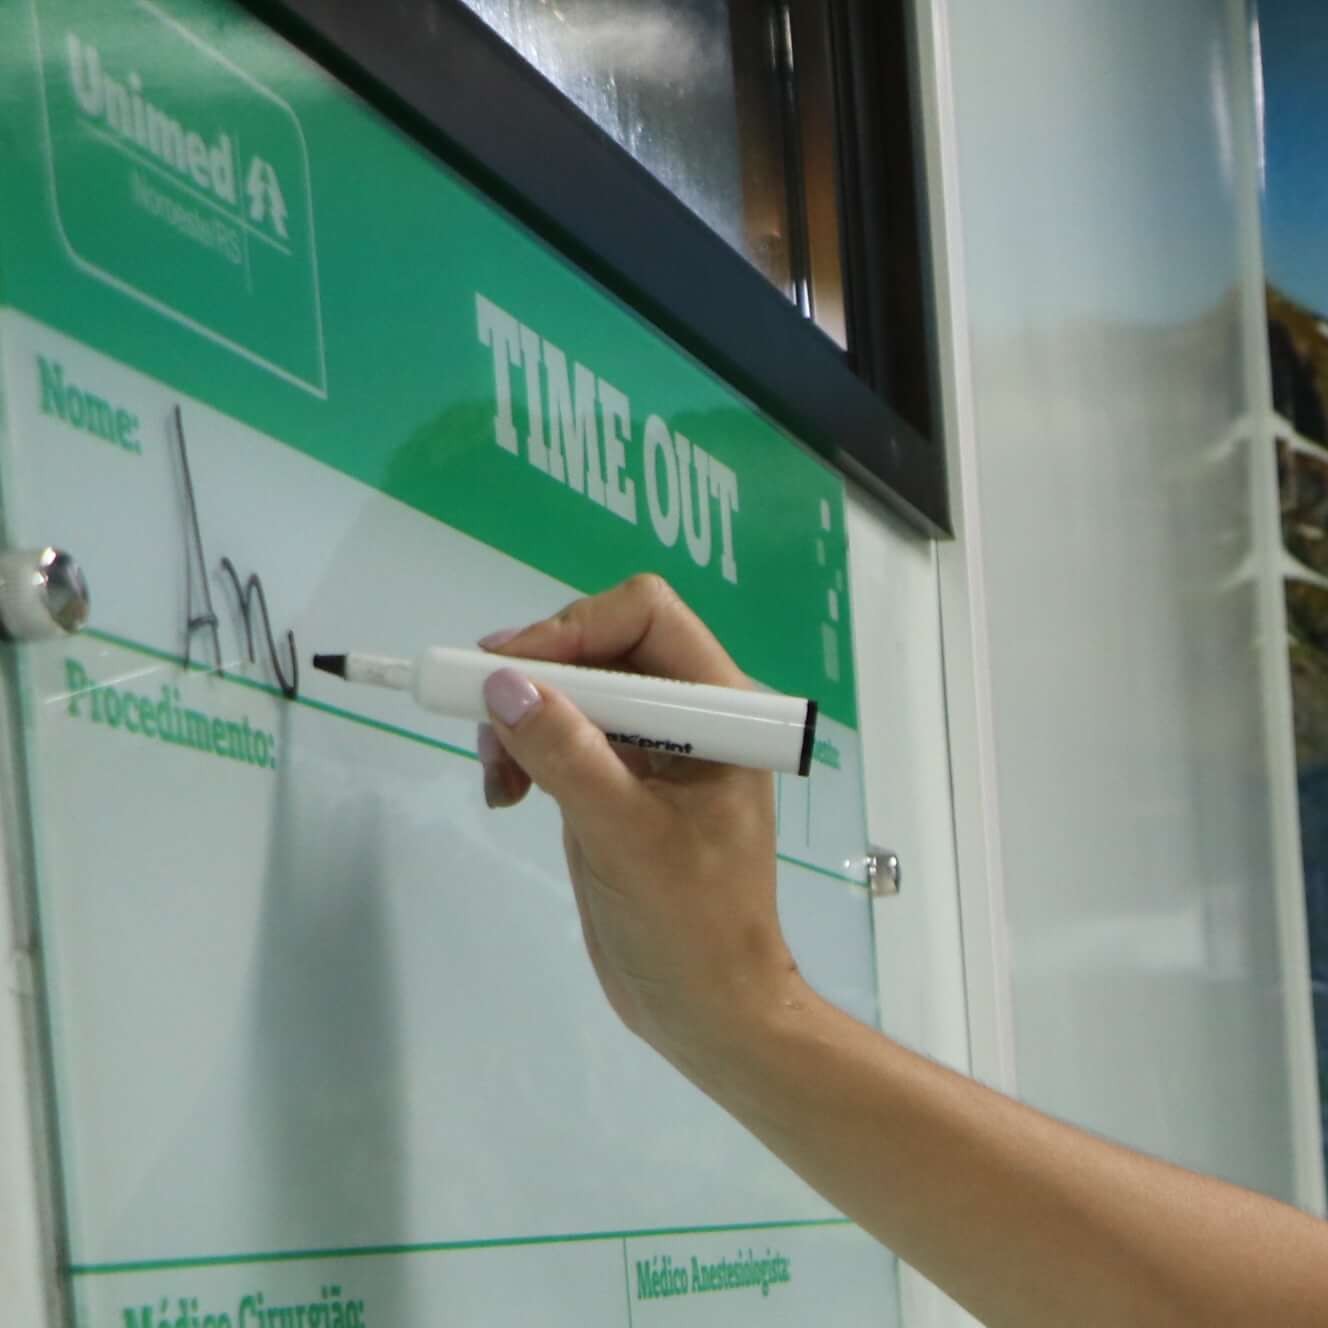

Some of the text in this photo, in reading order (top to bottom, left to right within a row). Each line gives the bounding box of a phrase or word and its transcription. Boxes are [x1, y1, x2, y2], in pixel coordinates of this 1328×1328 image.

[68, 33, 237, 205] Unimed
[36, 352, 143, 455] Nome:
[475, 291, 739, 585] TIME OUT
[65, 656, 277, 770] Procedimento:
[636, 1255, 689, 1300] Médico
